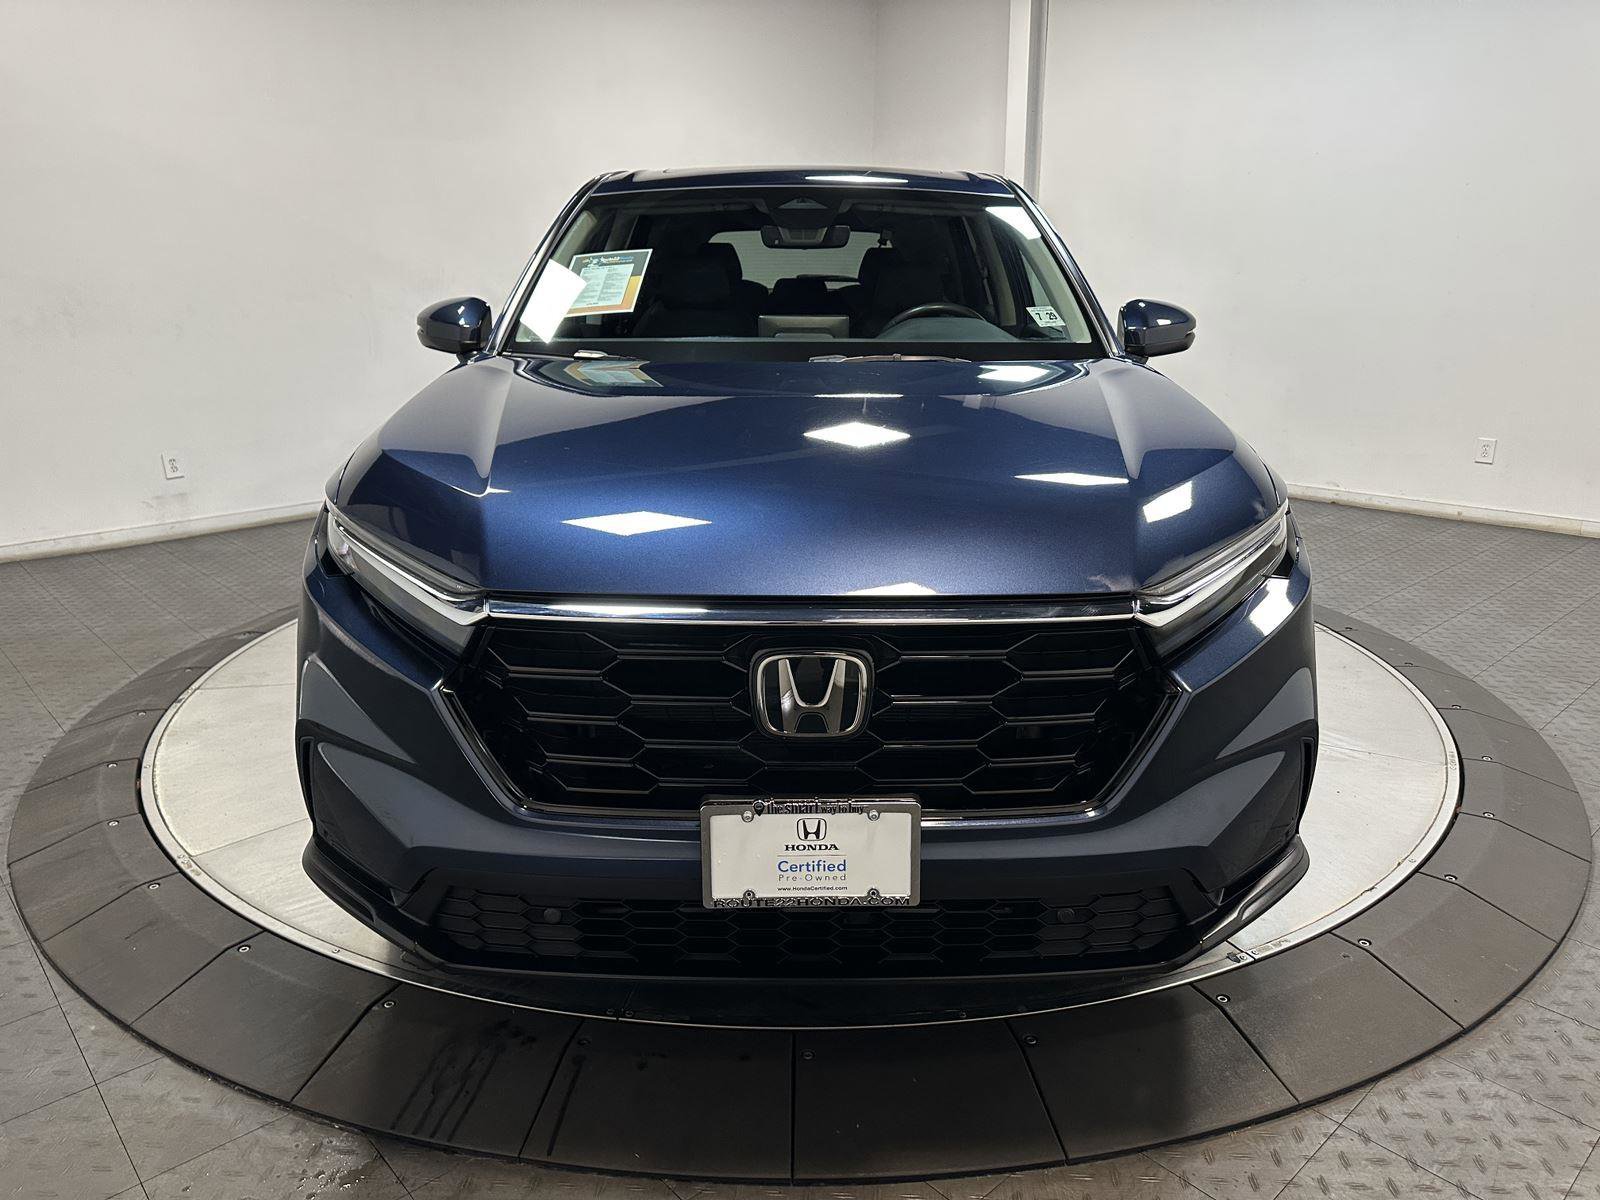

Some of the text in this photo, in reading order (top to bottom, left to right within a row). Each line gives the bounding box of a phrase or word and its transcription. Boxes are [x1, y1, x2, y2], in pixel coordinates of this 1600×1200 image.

[1035, 312, 1043, 321] 7
[767, 799, 864, 815] the smart way to buy
[784, 843, 839, 852] HONDA
[777, 860, 847, 873] Certified
[778, 874, 847, 882] Pre-Owned
[713, 896, 910, 909] ROUTE22HONDA.COM
